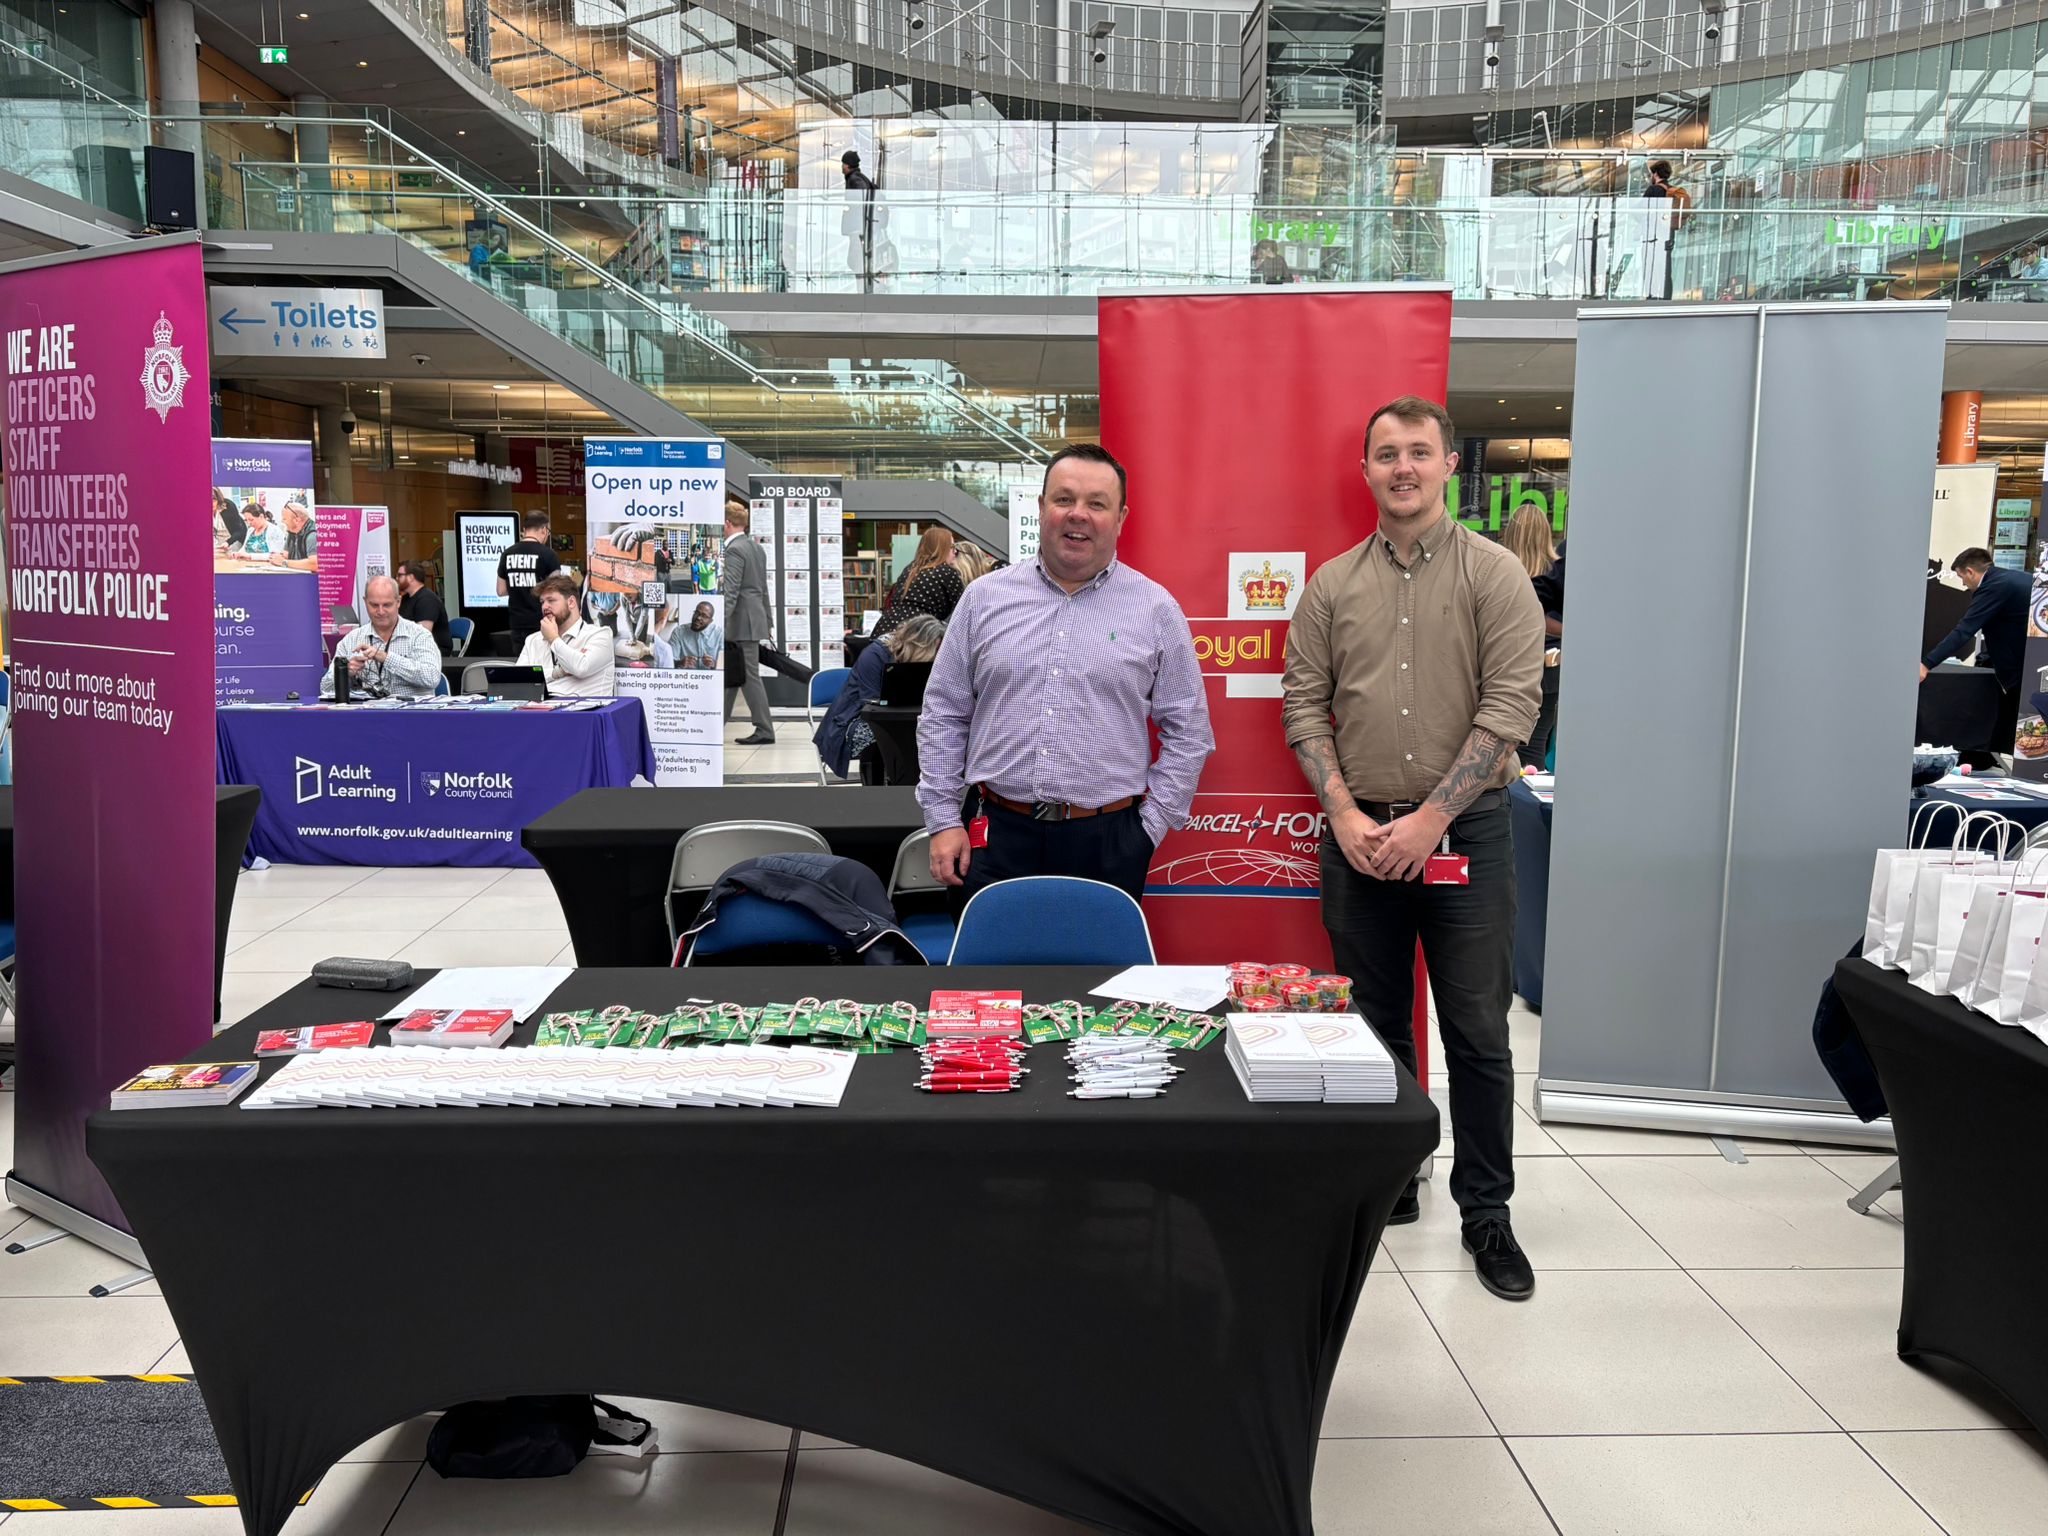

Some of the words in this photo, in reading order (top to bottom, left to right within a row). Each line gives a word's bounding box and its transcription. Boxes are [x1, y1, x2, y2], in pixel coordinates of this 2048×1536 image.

[1824, 219, 1946, 250] Library
[271, 302, 377, 328] Toilets
[8, 328, 32, 374] WE
[38, 324, 76, 372] ARE
[151, 353, 176, 368] NORFOLK
[8, 374, 96, 424] OFFICERS
[1964, 402, 1978, 447] Library
[9, 426, 61, 471] STAFF
[234, 458, 271, 468] Norfolk
[1473, 442, 1482, 472] Return
[592, 473, 642, 494] Open
[650, 478, 672, 495] up
[680, 479, 718, 490] new
[760, 487, 784, 496] JOB
[788, 486, 831, 497] BOARD
[10, 473, 128, 520] VOLUNTEERS
[1471, 480, 1480, 512] Borrow
[625, 499, 684, 517] doors!
[2000, 508, 2028, 518] Library
[333, 513, 346, 521] and
[330, 530, 336, 538] in
[466, 525, 510, 534] NORWICH
[11, 523, 140, 570] TRANSFEREES
[506, 554, 538, 570] EVENT
[508, 572, 536, 587] TEAM
[12, 568, 98, 616] NORFOLK
[104, 572, 168, 620] POLICE
[215, 644, 242, 654] an.
[14, 662, 40, 688] Find
[46, 668, 70, 690] out
[76, 674, 112, 695] more
[117, 674, 155, 700] about
[225, 676, 240, 684] Life
[649, 682, 699, 690] opportunities
[226, 686, 254, 694] Leisure
[14, 686, 58, 720] joining
[63, 696, 93, 716] our
[94, 698, 127, 722] team
[131, 702, 173, 735] today
[328, 764, 371, 780] Adult
[444, 772, 512, 788] Norfolk
[329, 783, 396, 802] Learning
[445, 788, 477, 800] County
[479, 788, 512, 798] Council
[298, 826, 514, 842] www.norfolk.gov.uk/adultlearning
